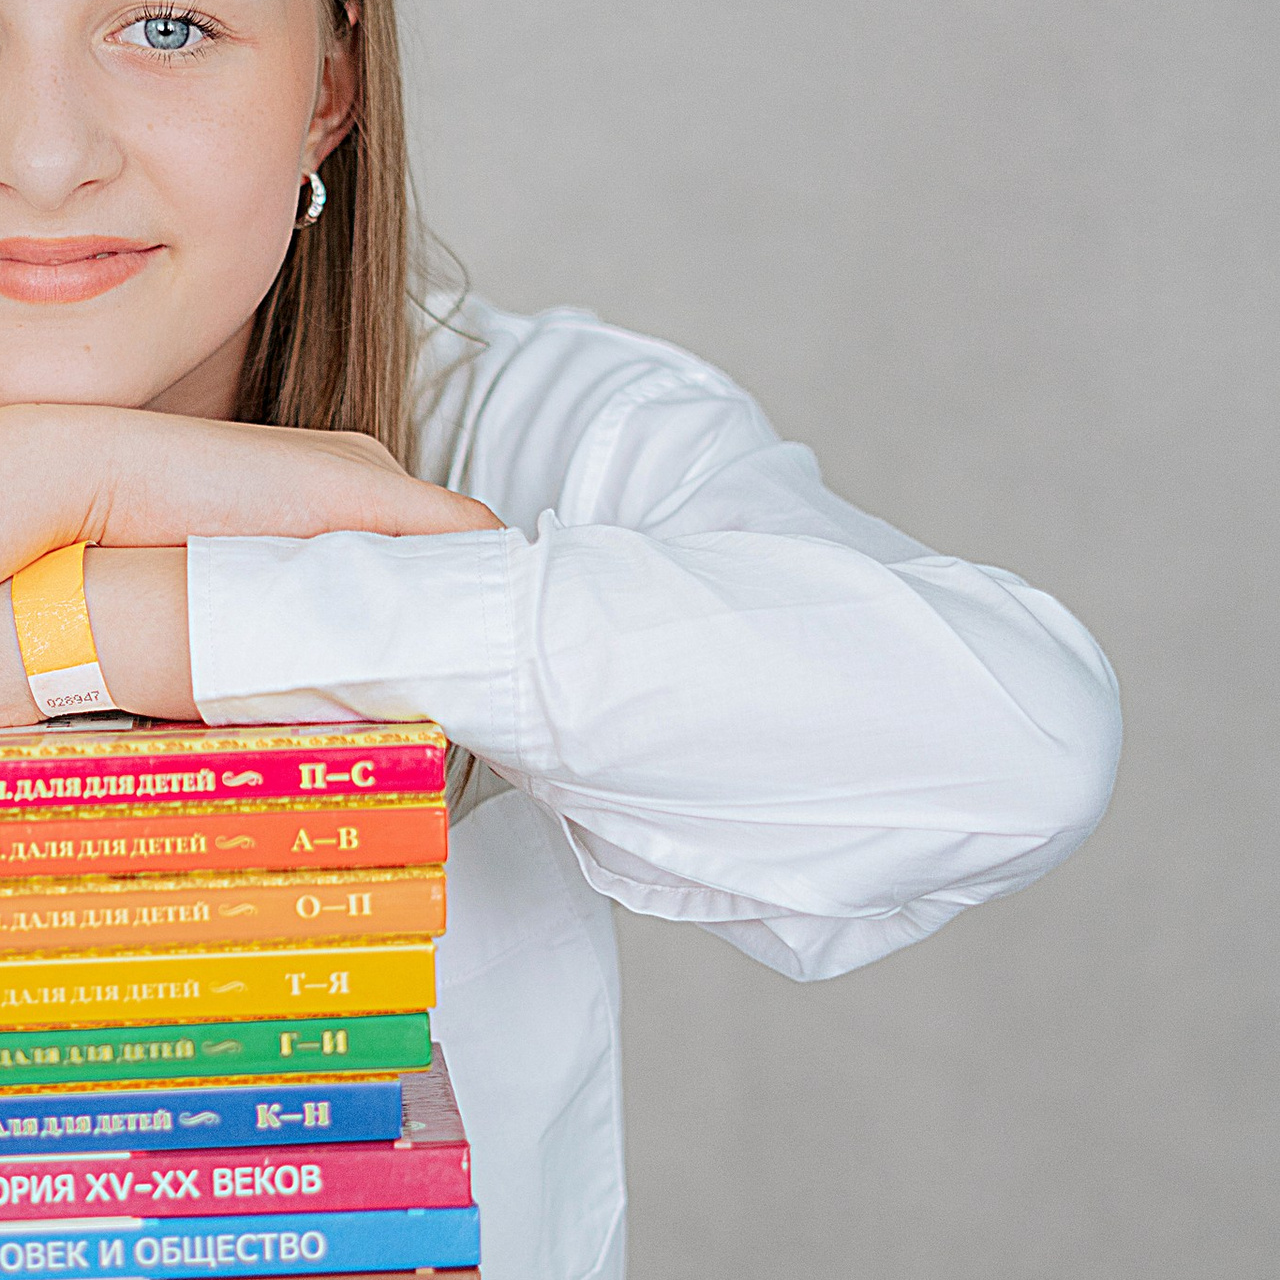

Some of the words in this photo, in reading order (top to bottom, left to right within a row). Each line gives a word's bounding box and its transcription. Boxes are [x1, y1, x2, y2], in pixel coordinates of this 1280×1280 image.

[46, 690, 100, 709] 028947
[15, 777, 81, 801] ДАЛЯ
[83, 774, 135, 798] ДЛЯ
[137, 768, 216, 796] ДЕТЕЙ
[10, 839, 73, 861] ДАЛЯ
[78, 838, 126, 859] ДЛЯ
[130, 833, 206, 857] ДЕТЕЙ
[11, 909, 75, 931] ДАЛЯ
[79, 907, 129, 928] ДЛЯ
[133, 901, 210, 926] ДЕТЕЙ
[1, 986, 66, 1007] ДАЛЯ
[70, 984, 120, 1005] ДЛЯ
[123, 979, 200, 1002] ДЕТЕЙ
[64, 1044, 114, 1065] ДЛЯ
[117, 1038, 195, 1063] ДЕТЕЙ
[42, 1115, 91, 1136] ДЛЯ
[94, 1110, 172, 1134] ДЕТЕЙ
[212, 1164, 322, 1197] ВЕКОВ
[100, 1238, 123, 1266] И
[134, 1230, 326, 1268] ОБЩЕСТВО
